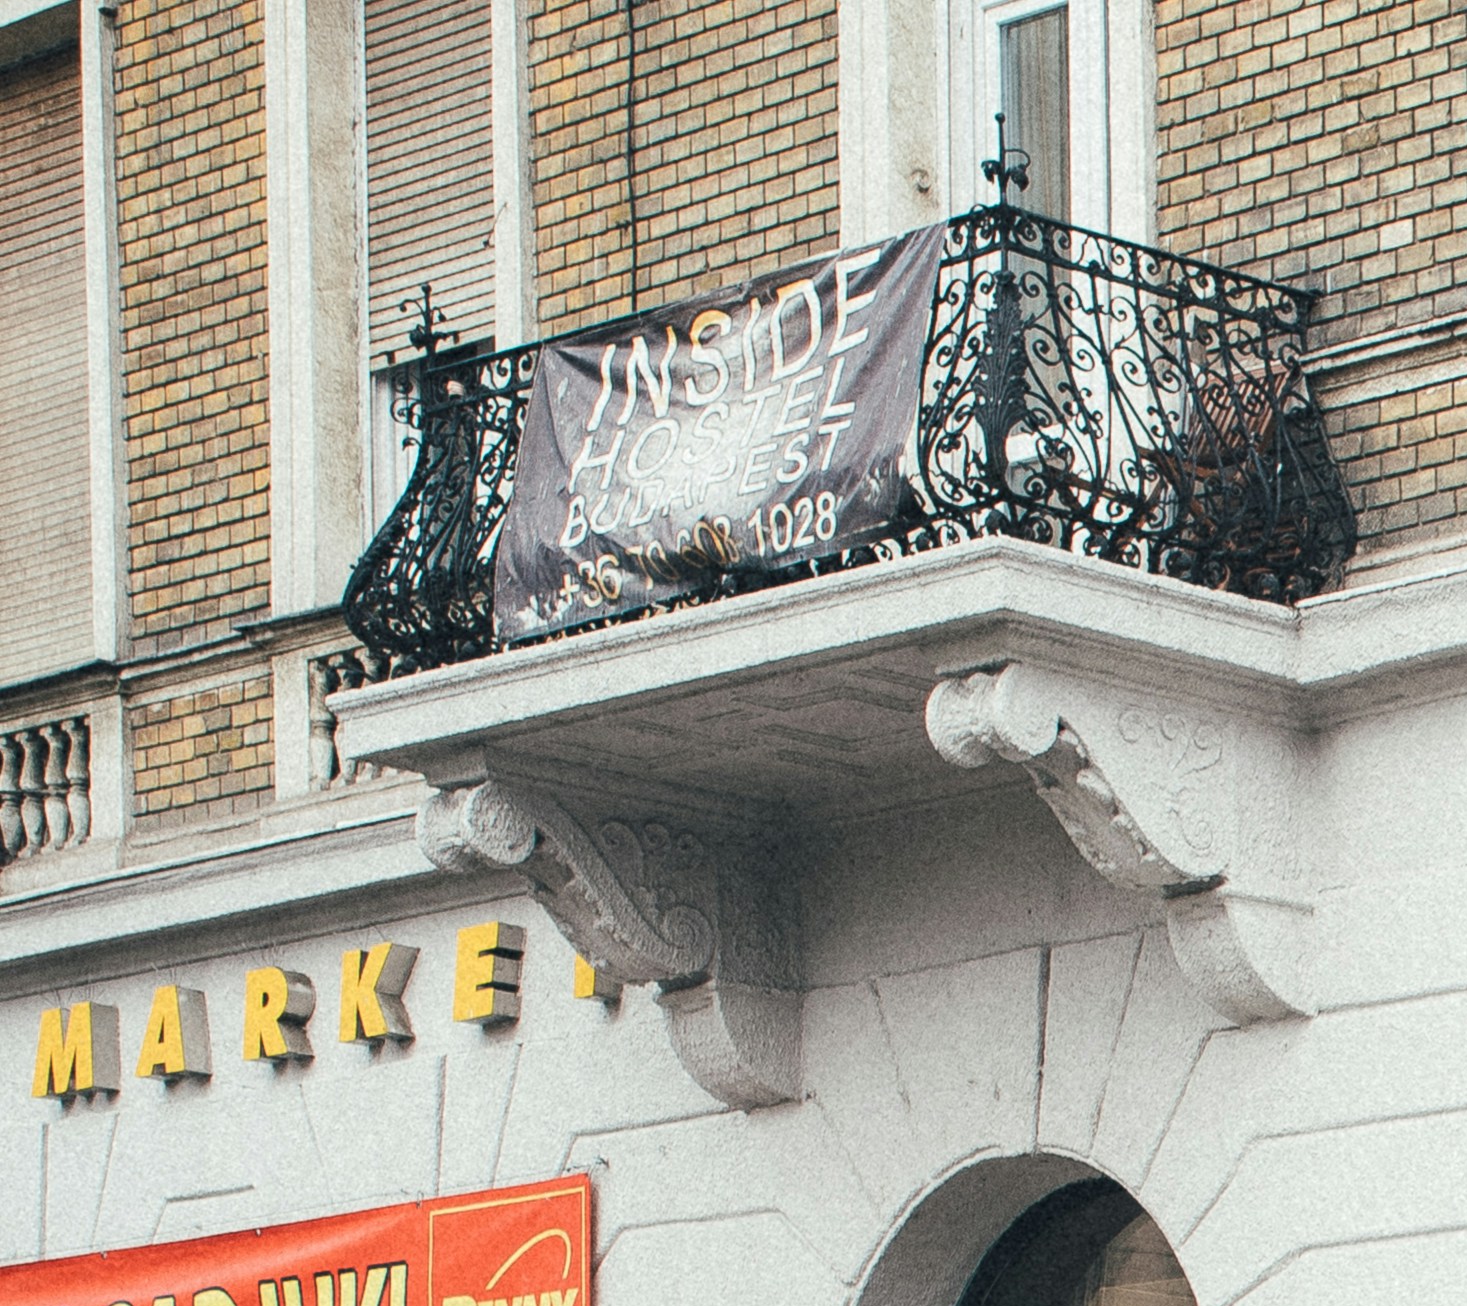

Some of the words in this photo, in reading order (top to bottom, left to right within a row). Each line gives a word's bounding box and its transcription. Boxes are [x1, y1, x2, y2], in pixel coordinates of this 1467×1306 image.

[587, 248, 881, 431] INSIDE
[559, 419, 851, 548] BUDAPEST
[569, 357, 856, 494] HOSTEL
[559, 554, 624, 609] +36
[748, 490, 838, 556] 1028
